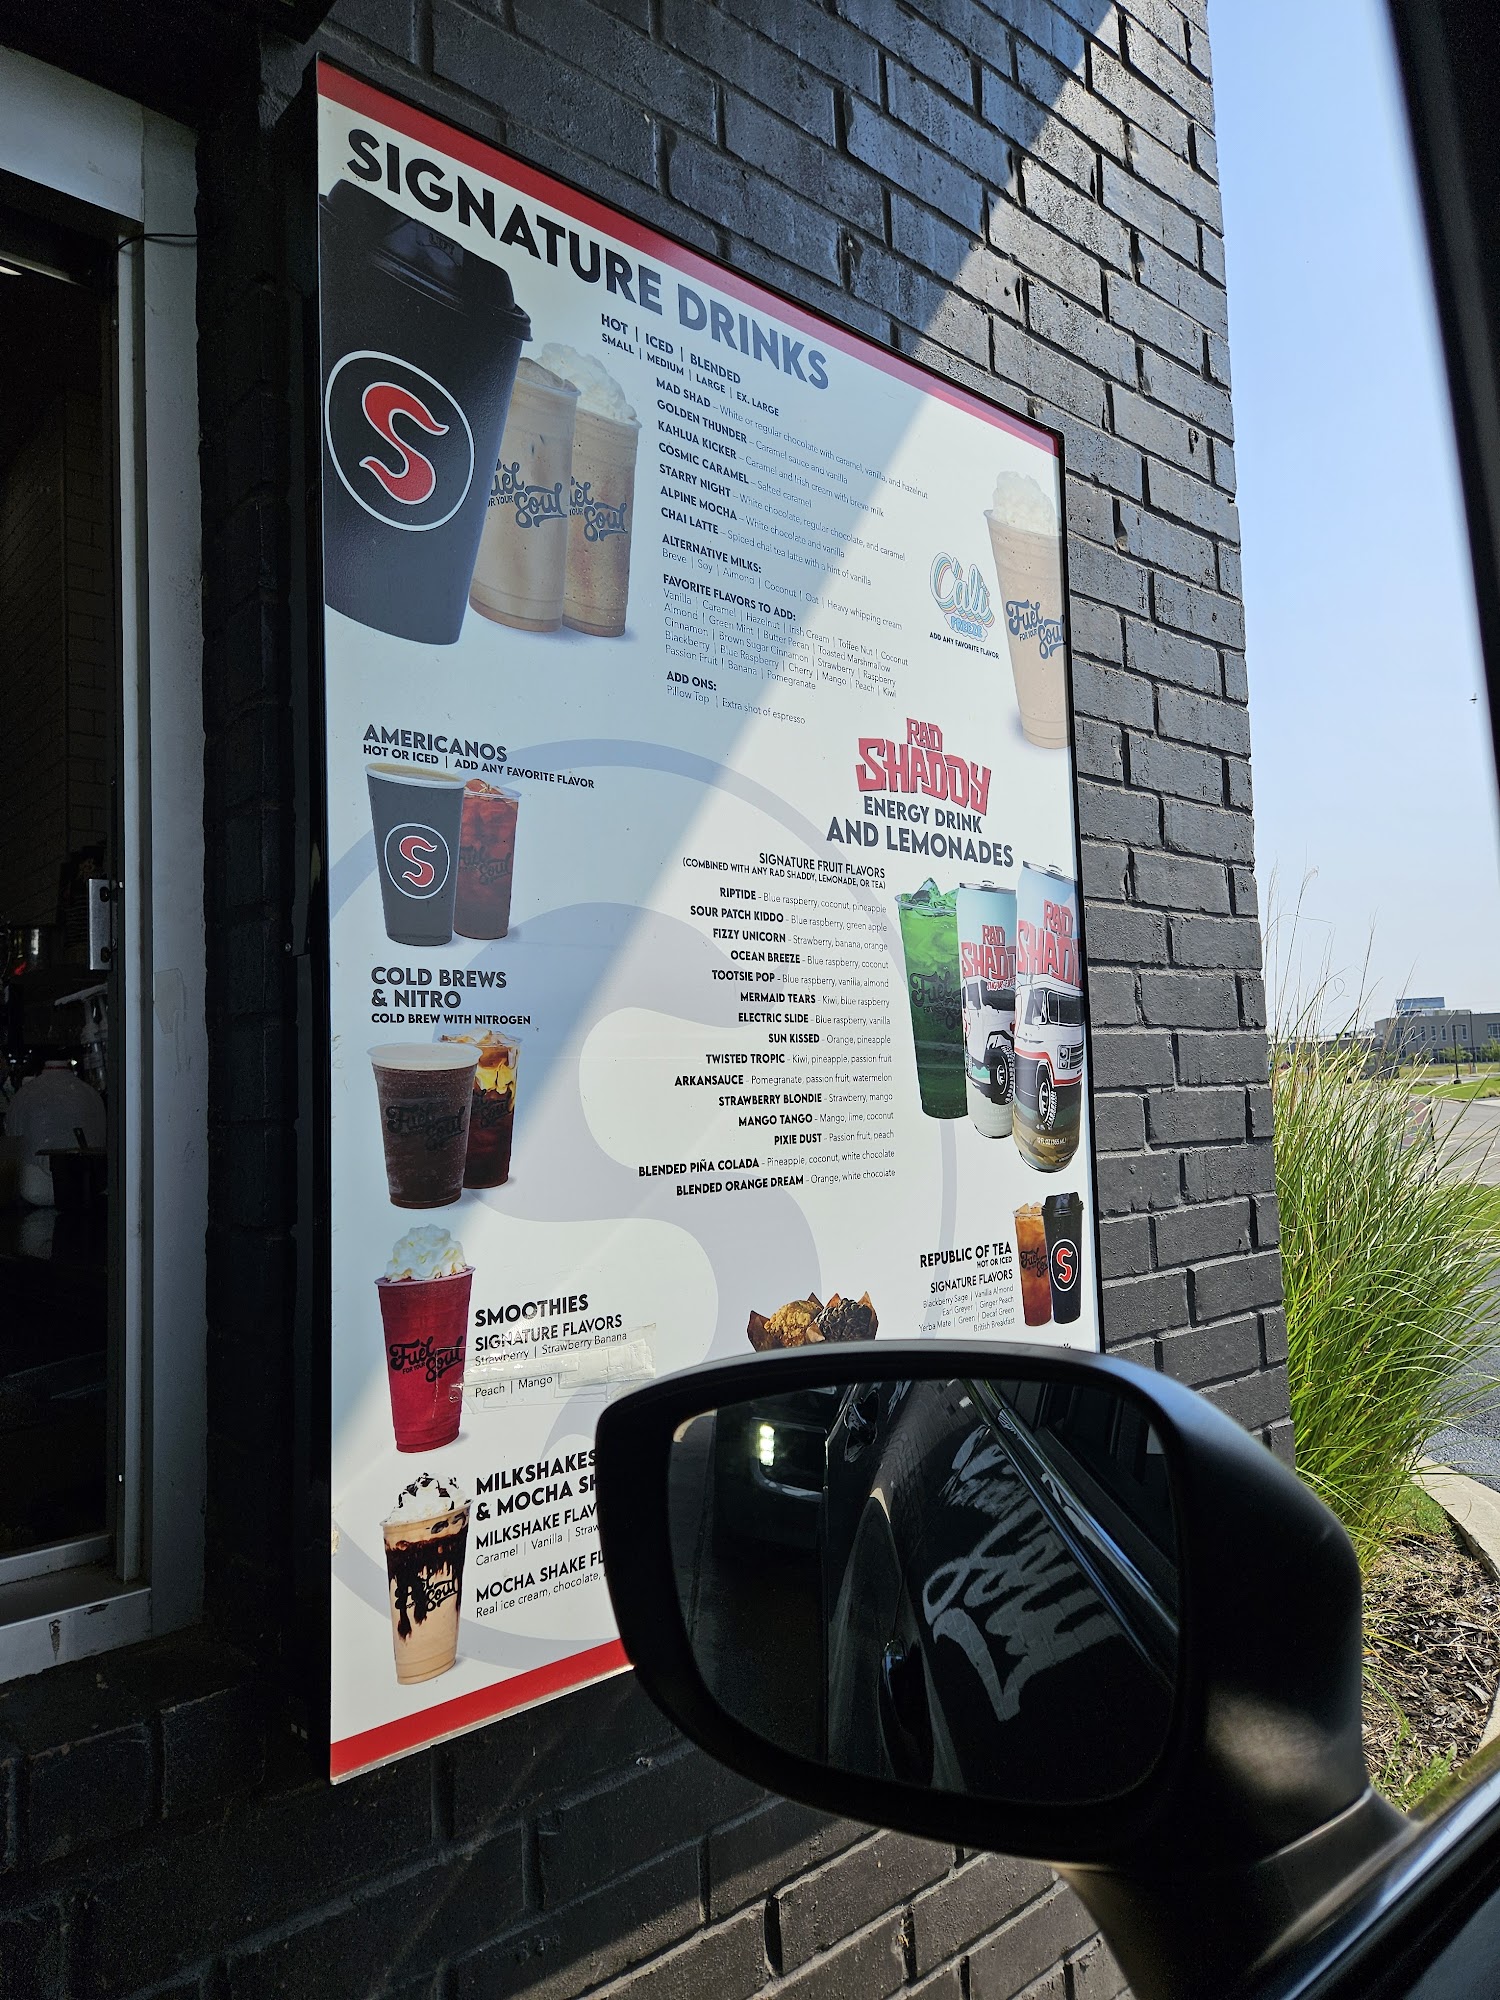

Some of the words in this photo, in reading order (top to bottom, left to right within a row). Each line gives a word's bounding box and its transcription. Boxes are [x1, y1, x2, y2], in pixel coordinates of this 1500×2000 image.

[346, 128, 663, 316] SIGNATURE
[677, 282, 829, 390] DRINKS
[601, 313, 629, 336] HOT
[645, 332, 674, 355] ICED
[690, 352, 741, 384] BLENDED
[601, 332, 635, 355] SMALL
[646, 351, 685, 376] MEDIUM
[695, 373, 726, 394] LARGE
[736, 390, 751, 405] EX.
[751, 397, 779, 417] LARGE
[656, 377, 681, 396] MAD
[682, 388, 711, 408] SHAD
[656, 399, 701, 425] GOLDEN
[701, 416, 747, 444] THUNDER
[657, 419, 700, 446] KAHLUA
[701, 437, 737, 460] KICKER
[658, 442, 700, 466] COSMIC
[701, 458, 750, 485] CARAMEL
[659, 463, 698, 486] STARRY
[699, 477, 731, 498] NIGHT
[660, 485, 697, 507] ALPINE
[699, 498, 738, 521] MOCHA
[660, 506, 687, 525] CHAI
[689, 515, 719, 535] LATTE
[661, 533, 729, 564] ALTERNATIVE
[730, 554, 762, 574] MILKS:
[663, 573, 712, 597] FAVORITE
[713, 588, 757, 610] FLAVORS
[757, 601, 772, 614] TO
[773, 606, 796, 622] ADD:
[929, 631, 942, 641] ADD
[942, 635, 954, 645] ANY
[954, 639, 980, 653] FAVORITE
[979, 647, 1000, 660] FLAVOR
[666, 670, 690, 685] ADD
[691, 676, 717, 692] ONS:
[362, 724, 508, 763] AMERICANOS
[906, 717, 943, 753] RAD
[363, 744, 389, 757] HOT
[391, 748, 410, 761] OR
[412, 751, 439, 765] ICED
[454, 758, 479, 771] ADD
[480, 762, 505, 775] ANY
[506, 766, 555, 783] FAVORITE
[556, 774, 595, 789] FLAVOR
[855, 737, 992, 817] SHADDY
[863, 795, 930, 825] ENERGY
[934, 808, 983, 834] DRINK
[825, 816, 879, 848] AND
[885, 825, 1014, 868] LEMONADES
[682, 857, 729, 872] (COMBINED
[730, 863, 750, 874] WITH
[751, 866, 768, 876] ANY
[769, 867, 786, 878] RAD
[786, 869, 817, 883] SHADDY,
[818, 873, 859, 888] LEMONADE,
[859, 878, 870, 888] OR
[871, 879, 886, 890] TEA)
[759, 852, 816, 871] SIGNATURE
[817, 859, 844, 874] FRUIT
[845, 863, 886, 879] FLAVORS
[719, 886, 757, 901] RIPTIDE
[690, 905, 719, 918] SOUR
[721, 907, 752, 921] PATCH
[753, 910, 784, 923] KIDDO
[712, 928, 740, 940] FIZZY
[742, 929, 786, 943] UNICORN
[730, 949, 766, 962] OCEAN
[767, 952, 801, 964] BREEZE
[371, 966, 433, 987] COLD
[438, 968, 507, 989] BREWS
[711, 969, 754, 982] TOOTSIE
[755, 971, 776, 983] POP
[371, 988, 389, 1008] &
[394, 989, 462, 1009] NITRO
[740, 991, 786, 1003] MERMAID
[787, 993, 816, 1004] TEARS
[371, 1012, 406, 1024] COLD
[407, 1013, 441, 1024] BREW
[442, 1013, 472, 1024] WITH
[474, 1014, 531, 1025] NITROGEN
[738, 1012, 782, 1023] ELECTRIC
[784, 1013, 809, 1024] SLIDE
[768, 1033, 788, 1044] SUN
[789, 1033, 820, 1044] KISSED
[705, 1053, 748, 1064] TWISTED
[749, 1053, 786, 1064] TROPIC
[674, 1074, 744, 1087] ARKANSAUCE
[718, 1094, 781, 1107] STRAWBERRY
[783, 1092, 823, 1104] BLONDIE
[738, 1114, 778, 1127] MANGO
[779, 1113, 813, 1125] TANGO
[774, 1134, 798, 1146] PIXIE
[799, 1132, 823, 1144] DUST
[638, 1163, 688, 1177] BLENDED
[689, 1158, 716, 1174] PIÑA
[717, 1157, 760, 1171] COLADA
[676, 1181, 723, 1196] BLENDED
[725, 1177, 769, 1192] ORANGE
[770, 1174, 804, 1188] DREAM
[919, 1247, 973, 1269] REPUBLIC
[975, 1244, 990, 1259] OF
[992, 1241, 1012, 1256] TEA
[976, 1259, 989, 1268] HOT
[989, 1257, 999, 1267] OR
[999, 1255, 1013, 1265] ICED
[930, 1274, 977, 1294] SIGNATURE
[978, 1268, 1013, 1285] FLAVORS
[475, 1293, 589, 1328] SMOOTHIES
[474, 1324, 559, 1352] SIGNATURE
[562, 1313, 623, 1337] FLAVORS
[474, 1350, 530, 1367] Strawberry
[541, 1338, 593, 1355] Strawberry
[593, 1332, 627, 1346] Banana
[475, 1379, 507, 1398] Peach
[517, 1372, 555, 1390] Mango
[476, 1448, 597, 1496] MILKSHAKES
[475, 1501, 491, 1522] &
[496, 1480, 574, 1517] MOCHA
[476, 1512, 560, 1550] MILKSHAKE
[475, 1543, 519, 1567] Caramel
[530, 1532, 563, 1550] Vanilla
[476, 1571, 536, 1603] MOCHA
[539, 1554, 586, 1583] SHAKE
[476, 1600, 498, 1618] Real
[500, 1598, 516, 1611] ice
[517, 1588, 551, 1605] cream,
[552, 1572, 600, 1594] chocolate,
